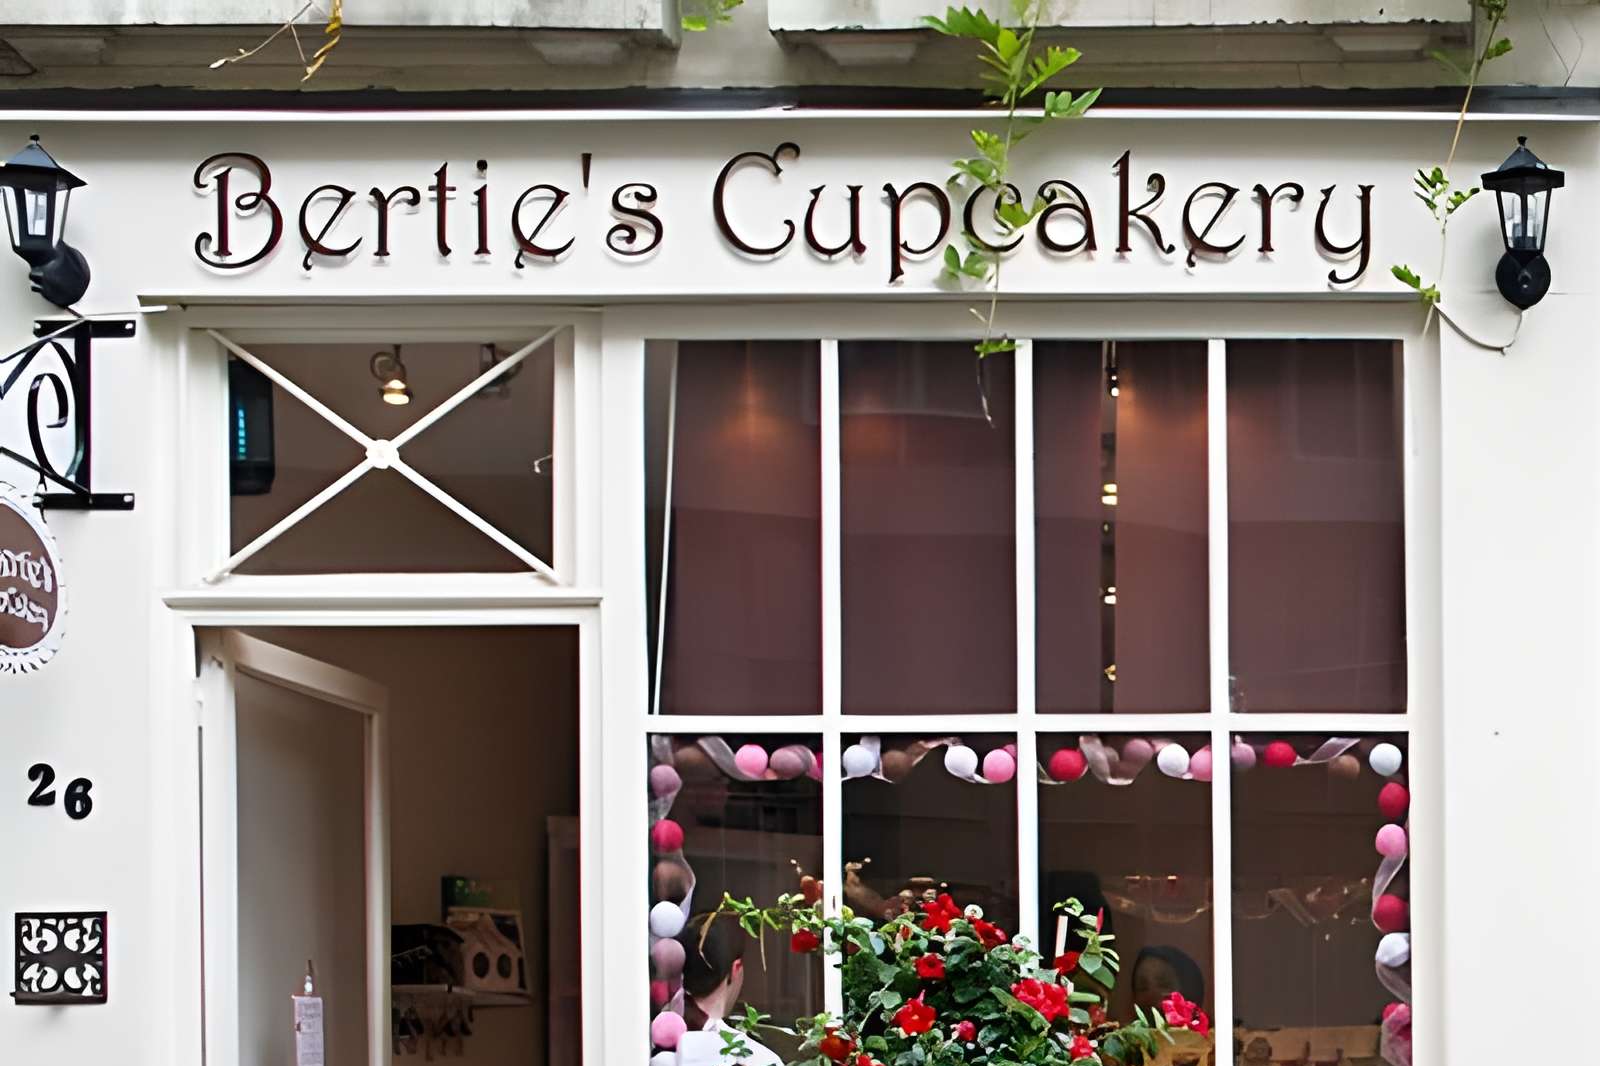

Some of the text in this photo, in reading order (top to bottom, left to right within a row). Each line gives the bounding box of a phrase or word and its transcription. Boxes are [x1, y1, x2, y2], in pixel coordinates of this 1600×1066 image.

[193, 142, 1375, 285] Bertie's Cupcakery
[27, 762, 94, 821] 26
